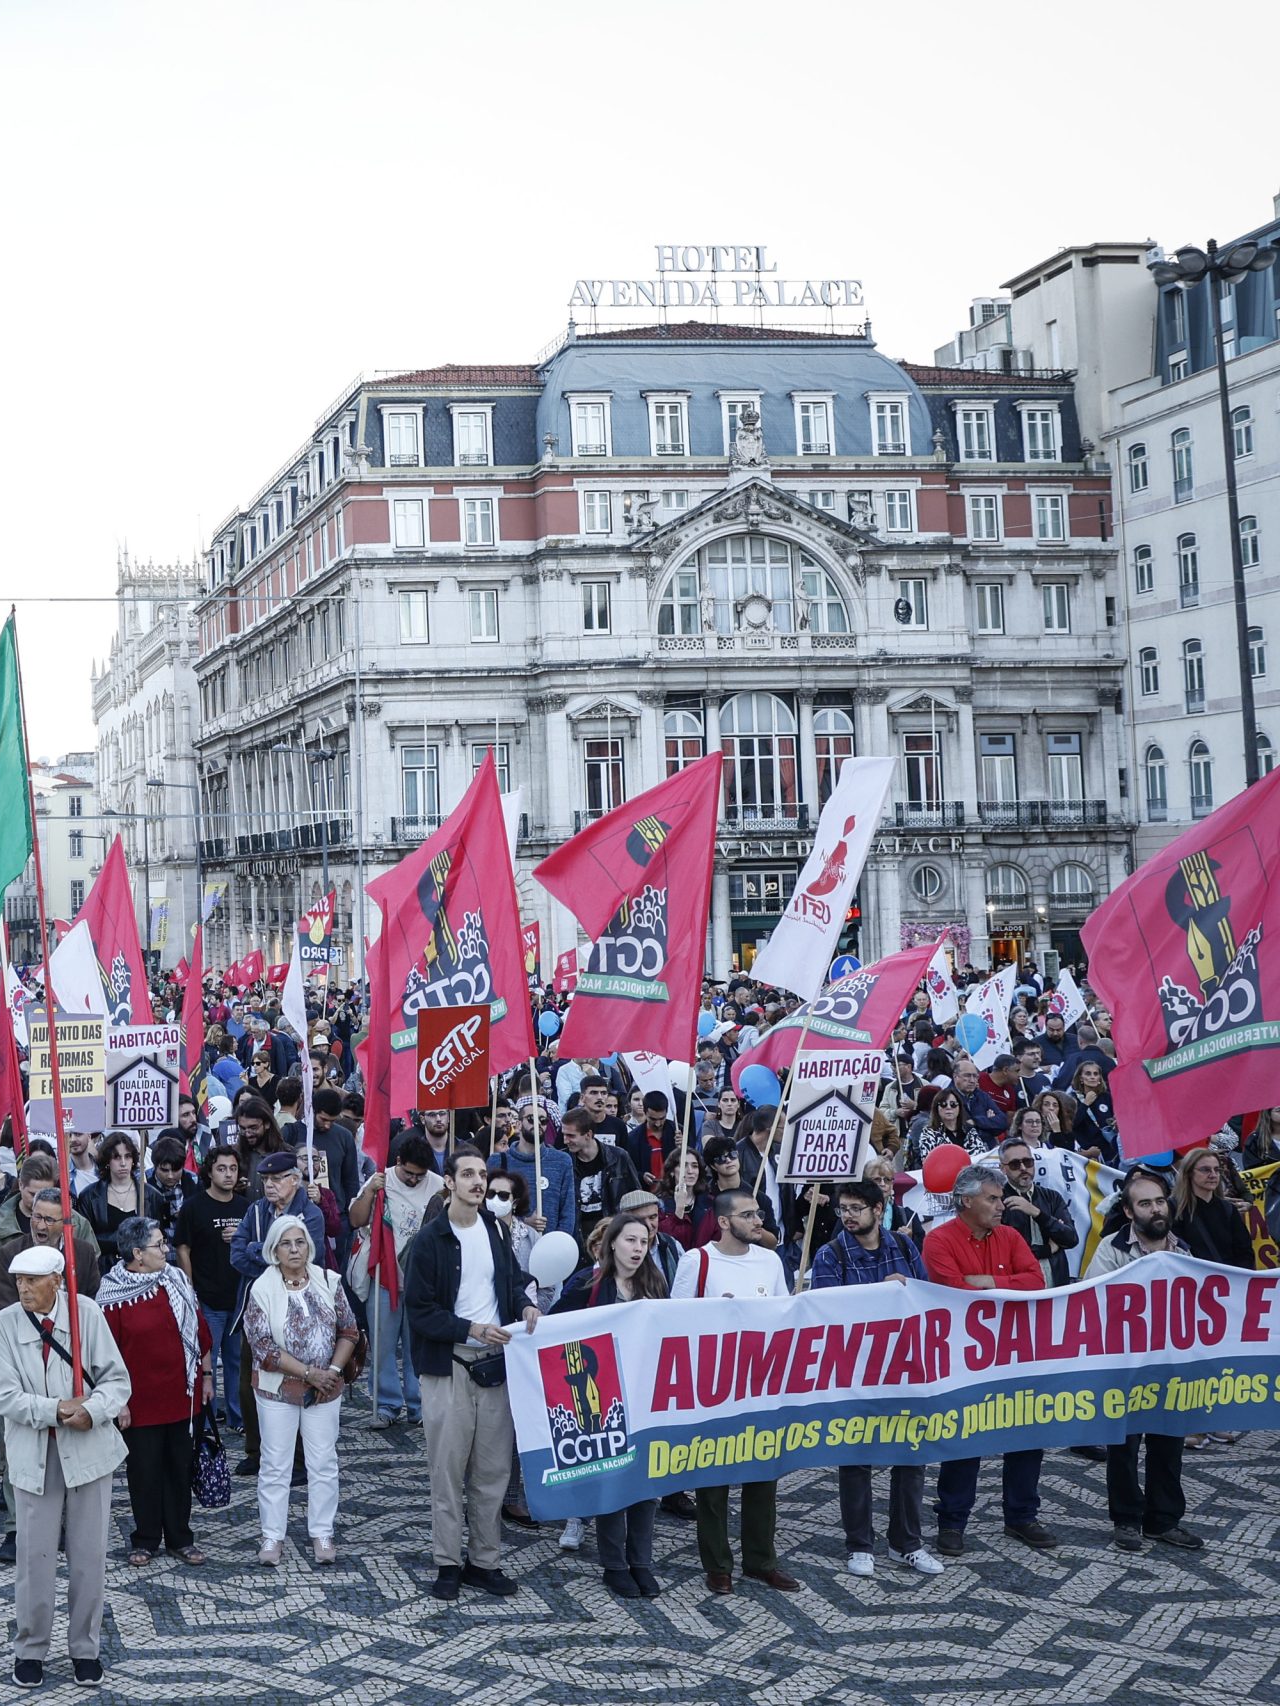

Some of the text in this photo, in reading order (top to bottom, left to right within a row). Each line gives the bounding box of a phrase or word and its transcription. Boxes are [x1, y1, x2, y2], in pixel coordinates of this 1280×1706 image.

[655, 245, 777, 272] HOTEL
[568, 279, 865, 306] AVENIDA PALACE
[716, 836, 963, 858] VENID ALACE
[32, 1024, 102, 1043] AUENTO DAS
[109, 1027, 179, 1050] HABITAÇÃO
[419, 1014, 482, 1086] CGTP
[137, 1069, 148, 1079] DE
[429, 1046, 485, 1096] PORTUGAL
[798, 1053, 882, 1080] HABITAÇÃO
[41, 1079, 47, 1095] E
[119, 1079, 166, 1090] QUALIDADE
[123, 1091, 161, 1106] PARA
[120, 1107, 165, 1122] TODOS
[825, 1106, 838, 1117] DE
[801, 1119, 858, 1132] QUALIDADE
[804, 1133, 847, 1152] PARA
[797, 1153, 849, 1173] TODOS
[650, 1307, 951, 1412] AUMENTAR
[1240, 1277, 1279, 1342] E
[647, 1427, 785, 1479] Defender
[785, 1424, 820, 1451] os
[825, 1411, 957, 1450] serviços
[962, 1387, 1096, 1441] públicos
[1103, 1388, 1126, 1419] e
[1127, 1382, 1161, 1413] as
[1164, 1368, 1270, 1414] funções
[557, 1430, 626, 1465] CGTP
[550, 1456, 634, 1483] INTERSINDICAL NACIONAL
